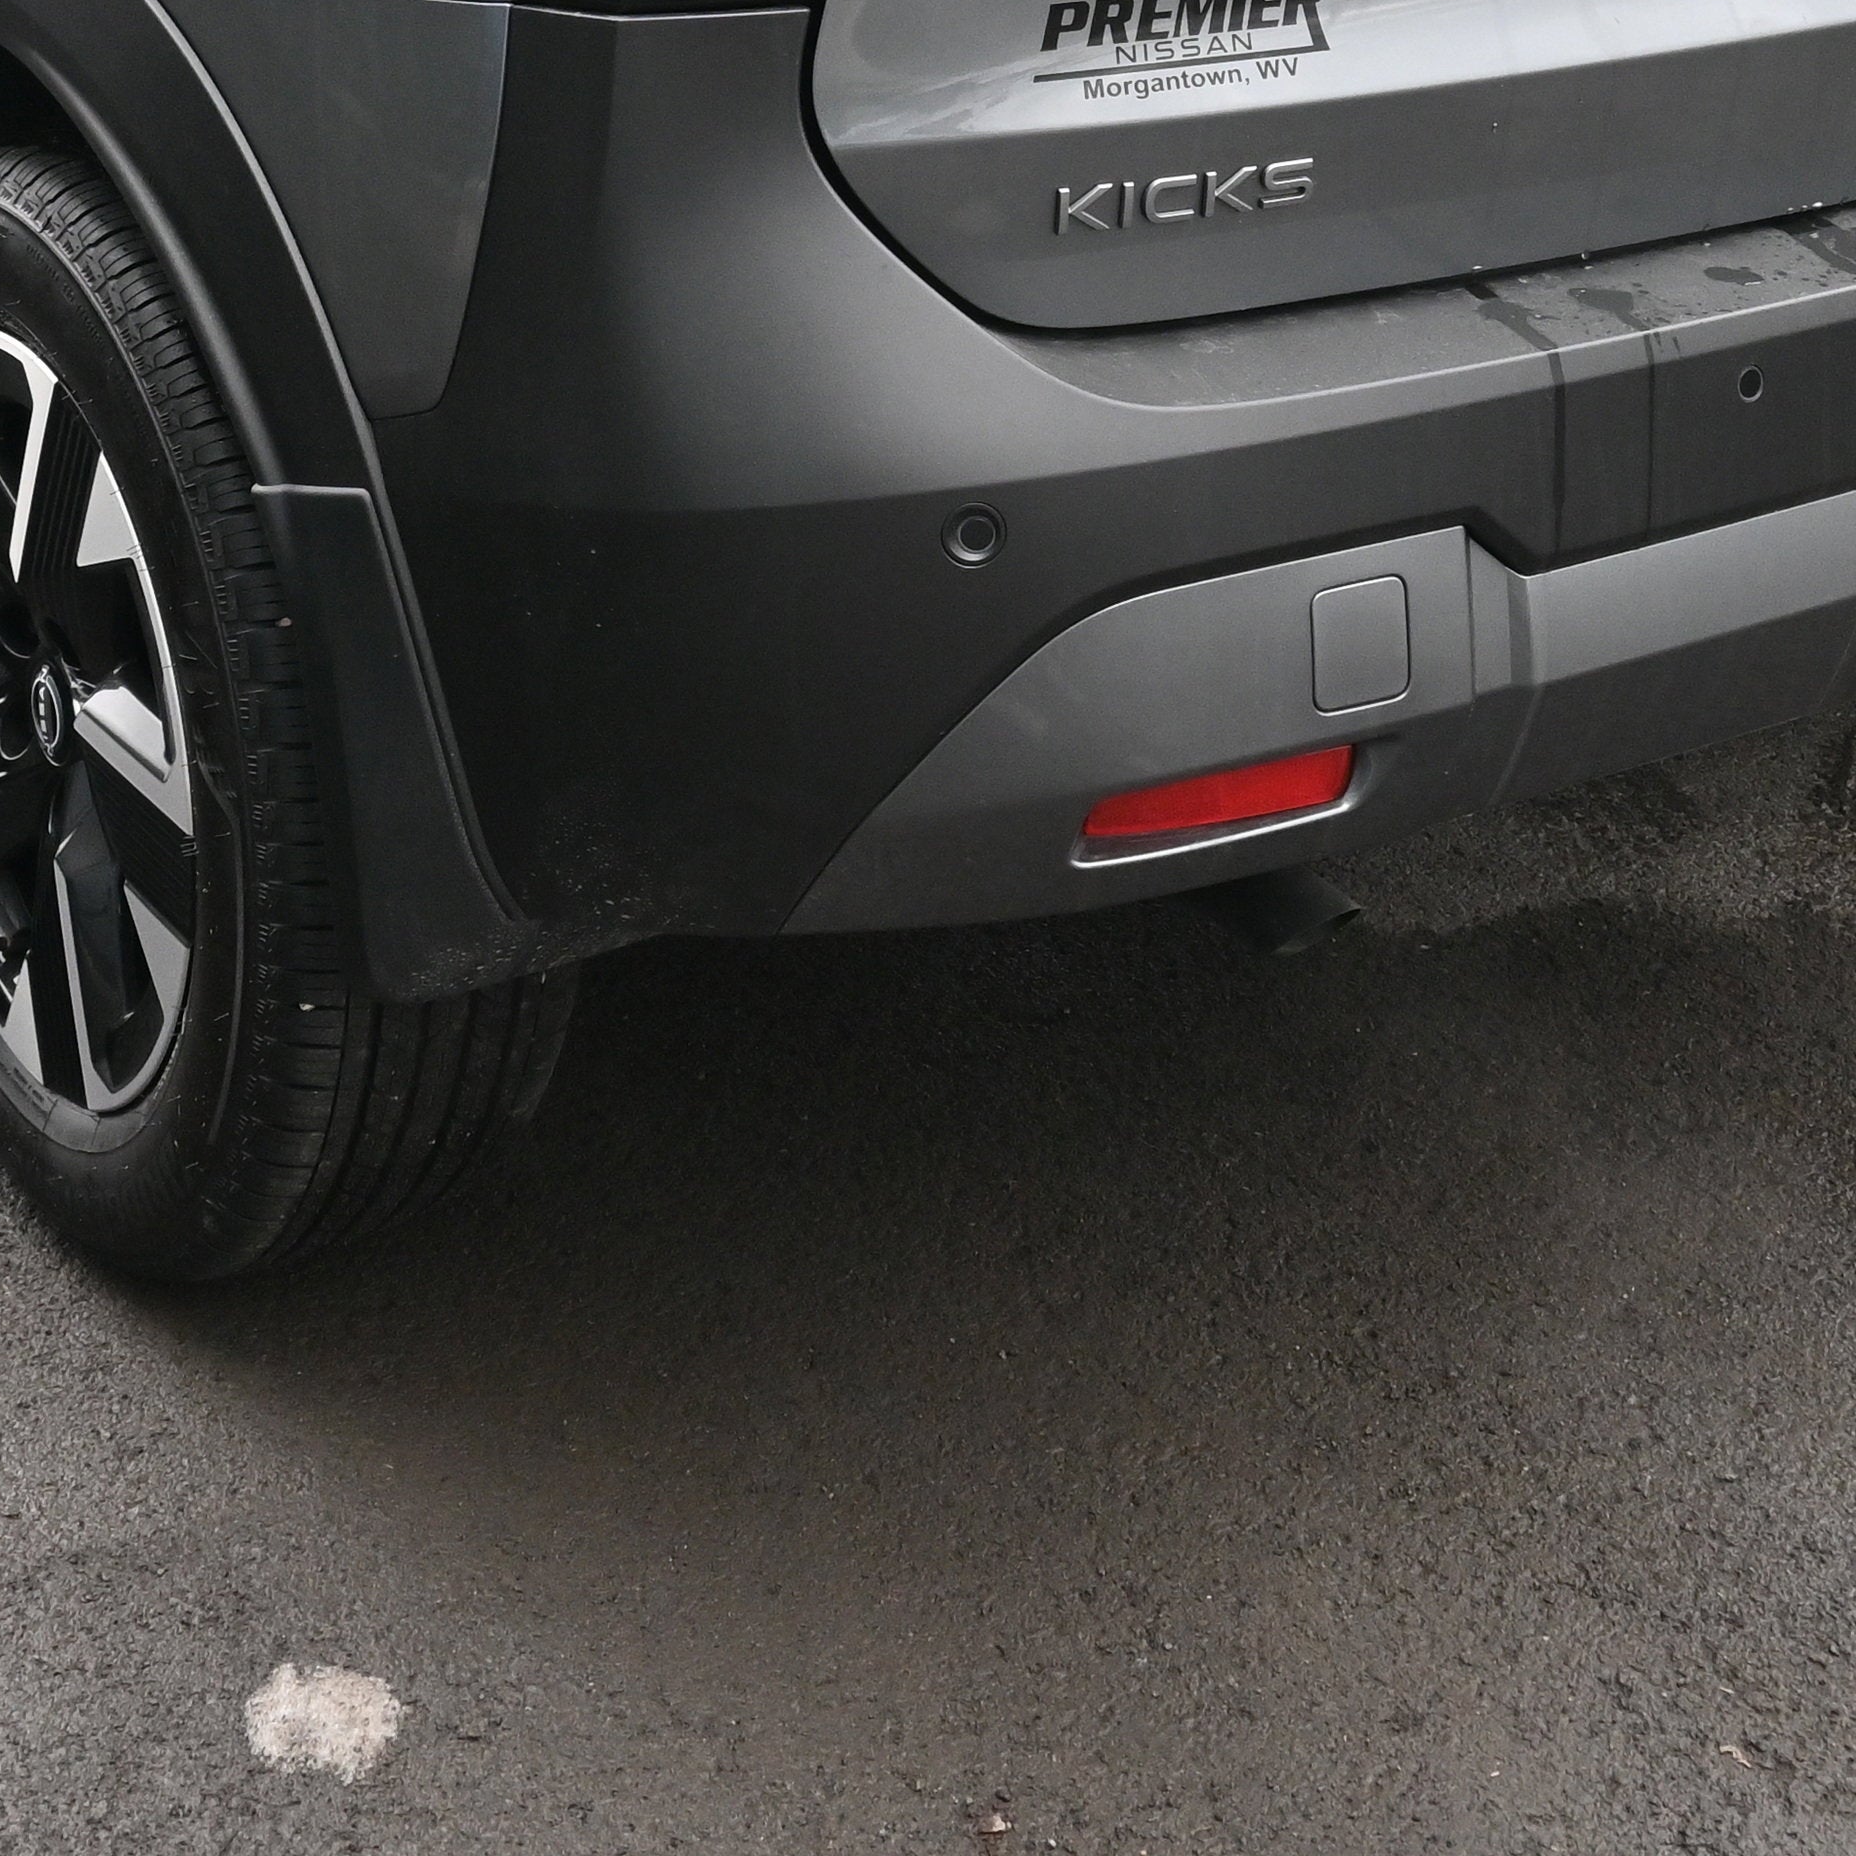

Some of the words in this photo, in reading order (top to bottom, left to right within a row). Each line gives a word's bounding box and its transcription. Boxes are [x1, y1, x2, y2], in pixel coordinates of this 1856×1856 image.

[1115, 31, 1253, 64] NISSAN
[1082, 67, 1251, 99] Morgantown,
[1256, 57, 1299, 80] WV
[1054, 157, 1314, 236] KICKS
